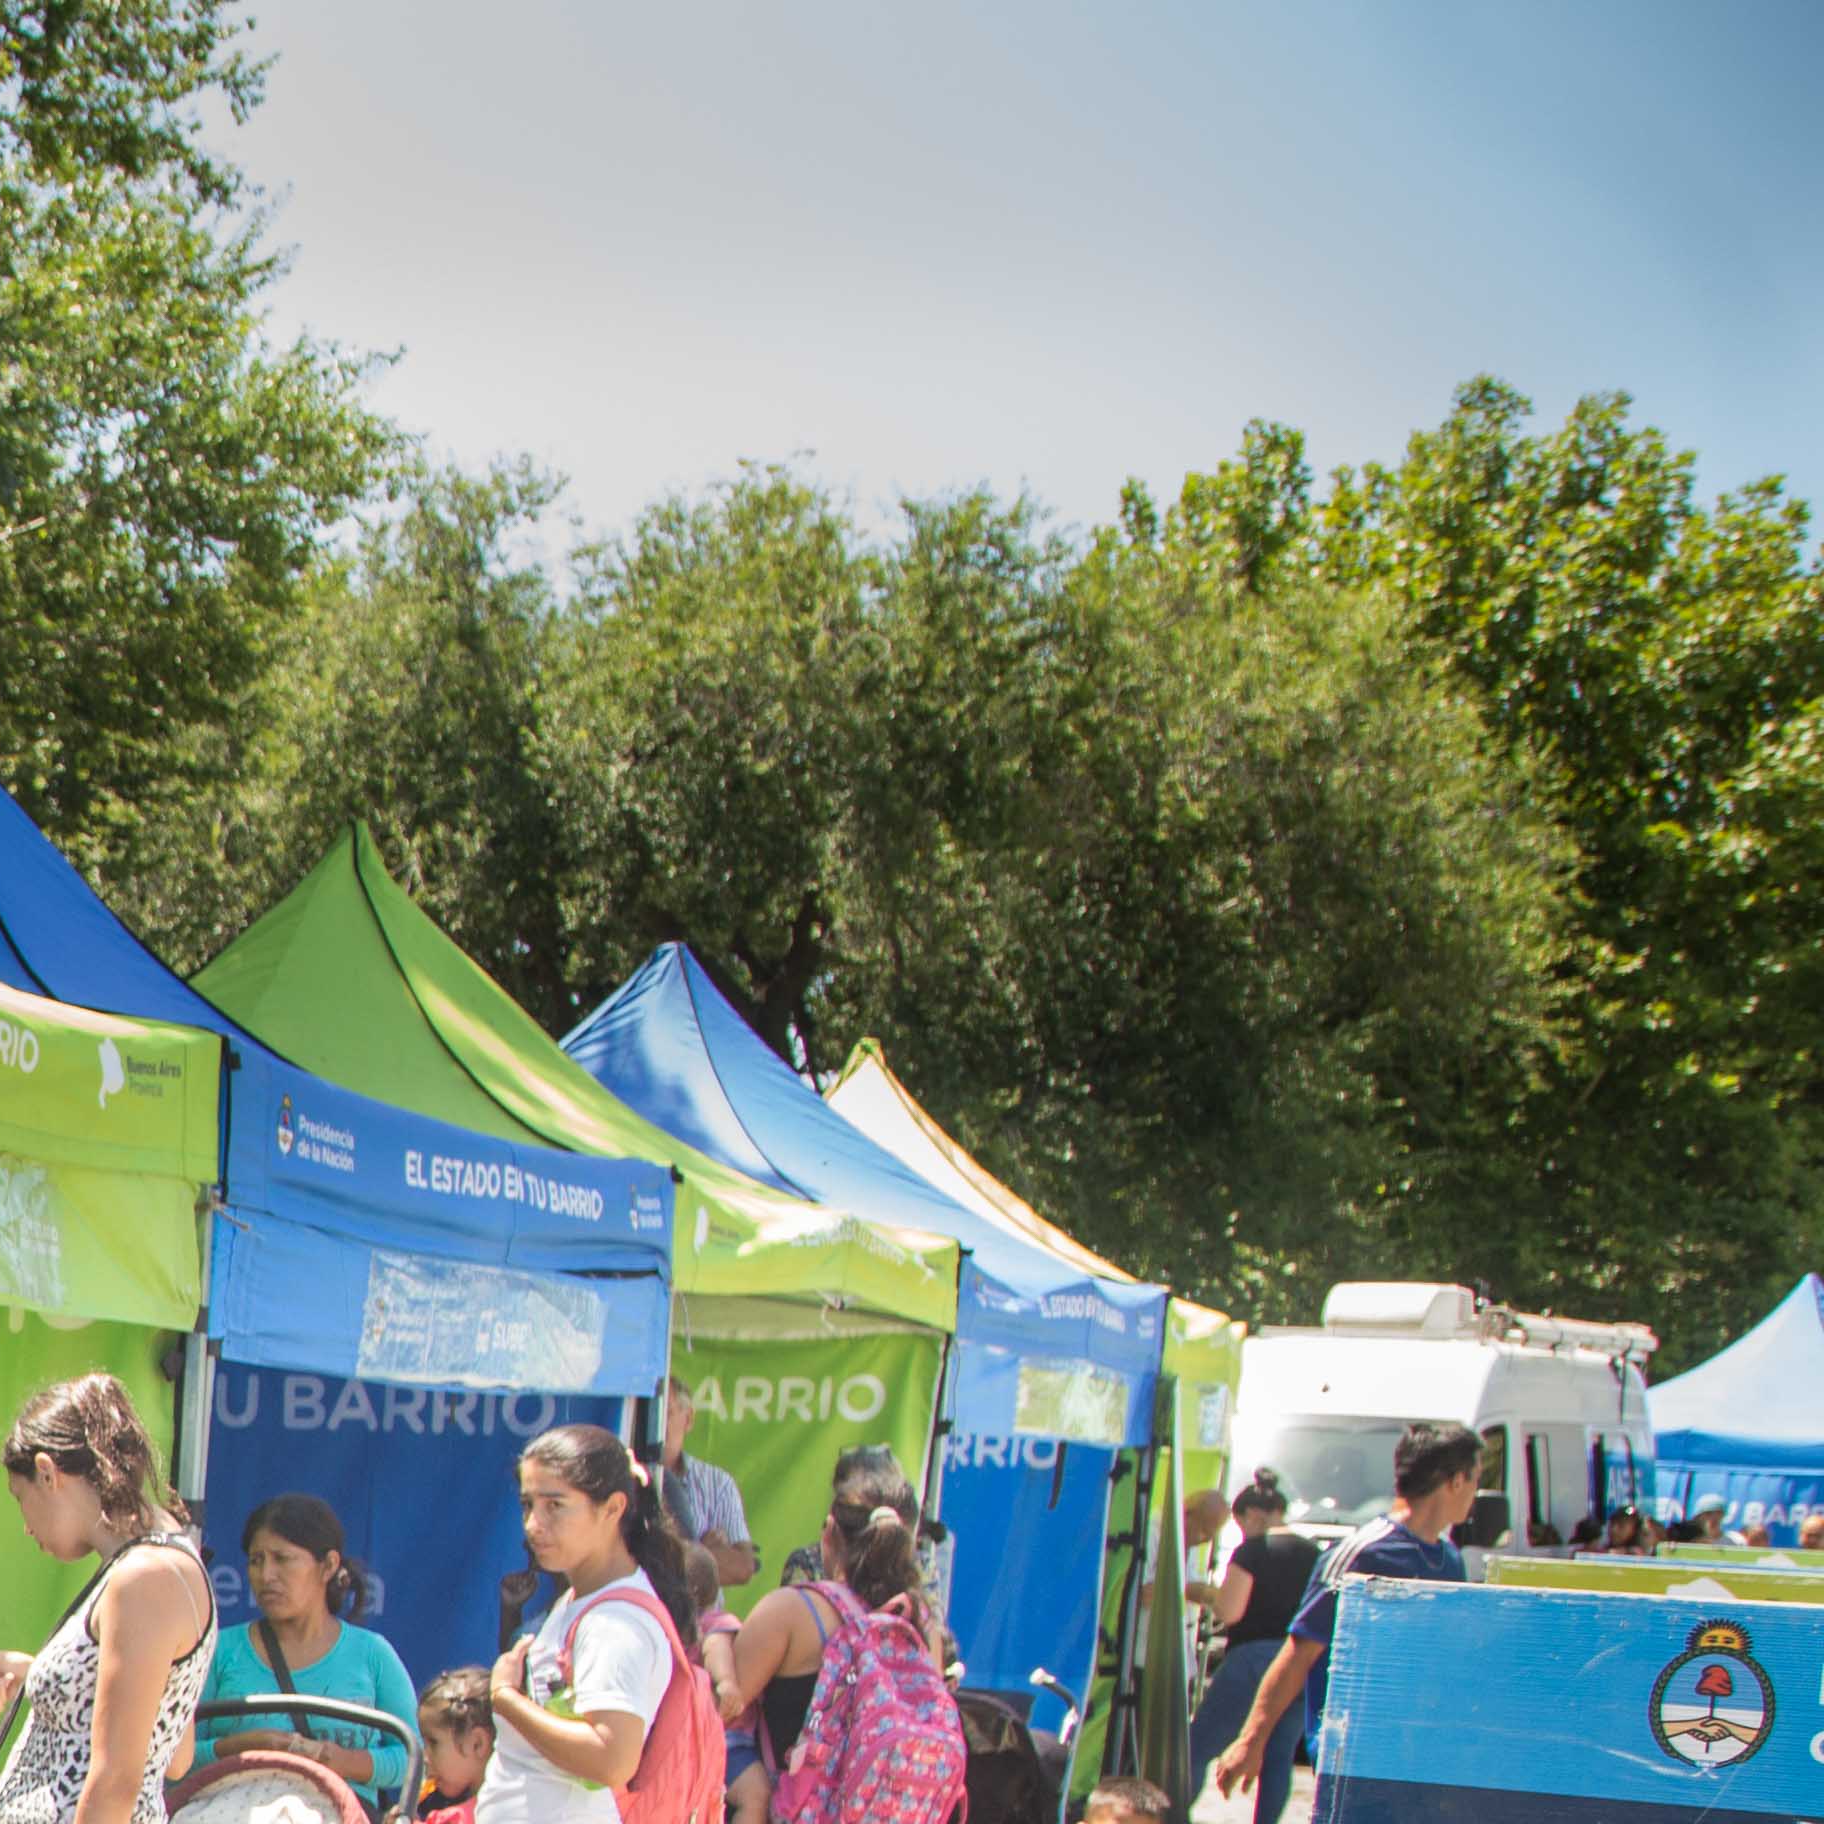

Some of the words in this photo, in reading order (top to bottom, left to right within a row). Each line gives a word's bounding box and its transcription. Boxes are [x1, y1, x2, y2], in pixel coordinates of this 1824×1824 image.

[298, 1114, 355, 1150] Presidencia
[405, 1150, 428, 1189] EL
[431, 1156, 499, 1199] ESTADO
[504, 1165, 524, 1201] EN
[525, 1172, 547, 1210] TU
[549, 1177, 603, 1222] BARRIO
[283, 1375, 556, 1437] BARRIO
